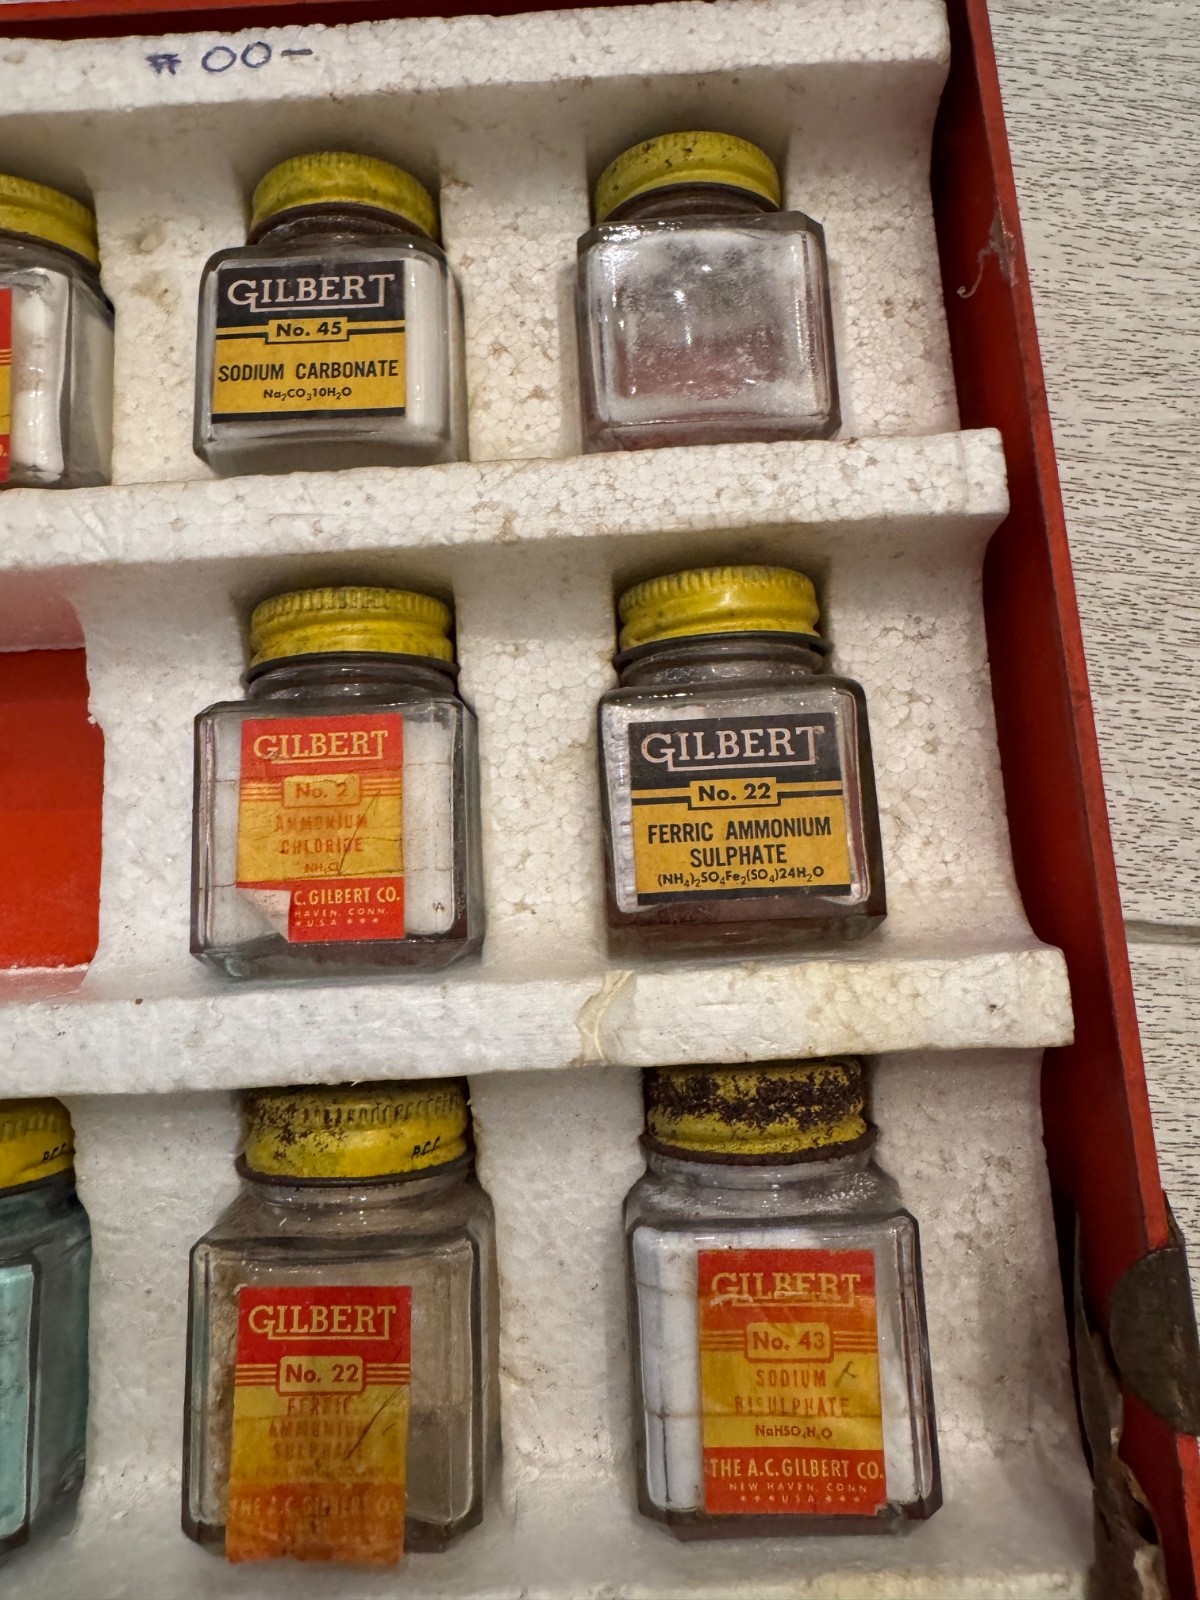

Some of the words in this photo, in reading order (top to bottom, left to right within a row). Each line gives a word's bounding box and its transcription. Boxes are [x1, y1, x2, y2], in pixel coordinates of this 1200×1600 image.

[227, 273, 395, 312] GILBERT
[276, 323, 310, 337] No.
[317, 321, 342, 335] 45
[218, 363, 284, 382] SODIUM
[295, 360, 399, 380] CARBONATE
[253, 730, 388, 764] GILBERT
[641, 725, 825, 771] GILBERT
[295, 782, 328, 798] No.
[698, 785, 737, 801] No.
[743, 783, 771, 800] 22
[648, 822, 714, 844] FERRIC
[725, 816, 832, 841] AMMONIUM
[690, 843, 788, 867] SULPHATE
[376, 886, 400, 903] CO.
[711, 1271, 861, 1308] GILBERT
[249, 1304, 397, 1340] GILBERT
[753, 1331, 790, 1351] No.
[798, 1331, 825, 1351] 43
[285, 1363, 322, 1384] No.
[331, 1363, 359, 1384] 22
[756, 1369, 826, 1389] SODIUM
[710, 1457, 742, 1478] THE
[857, 1460, 884, 1480] CO.
[729, 1482, 758, 1491] NEW
